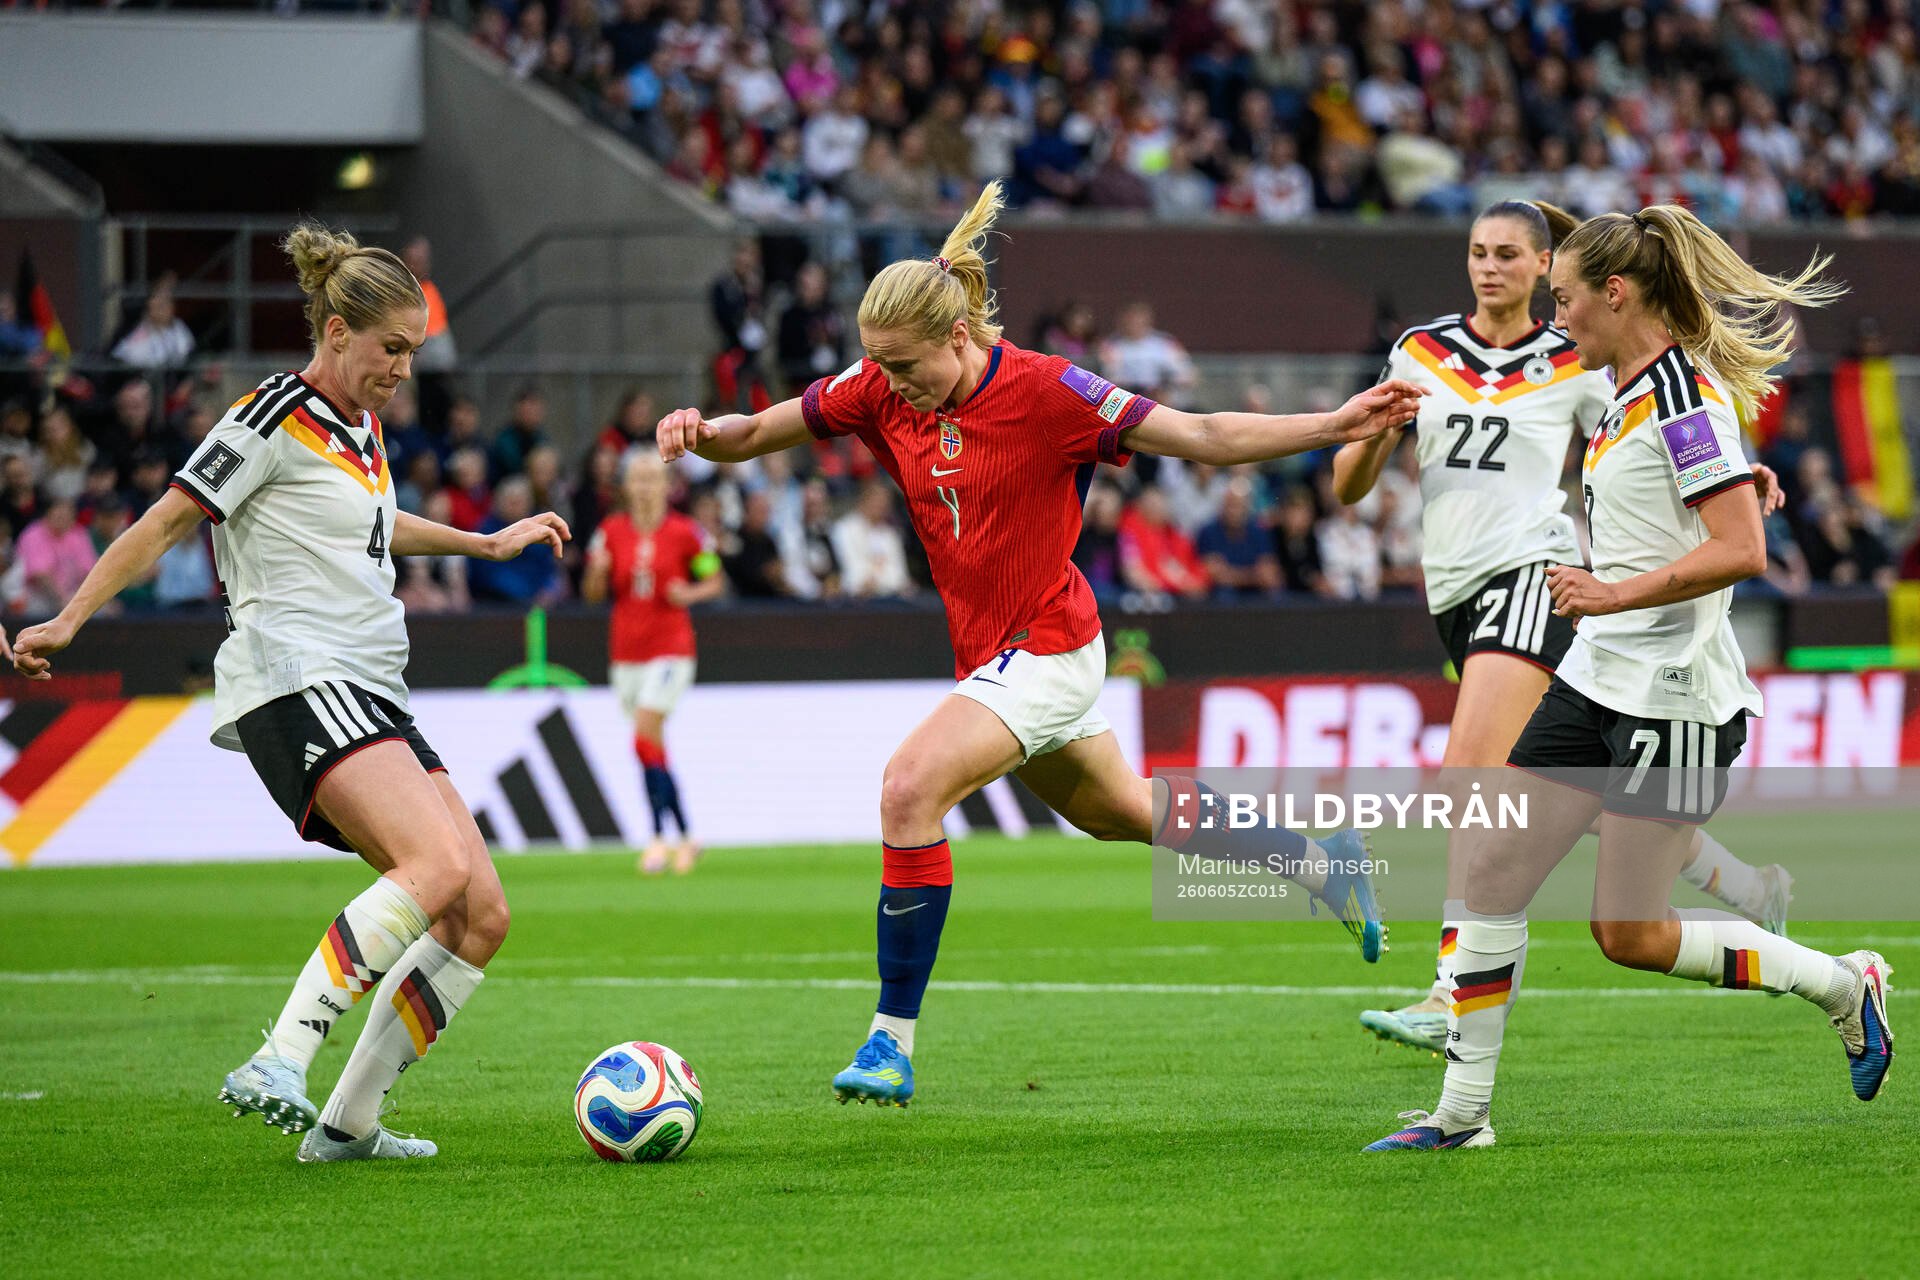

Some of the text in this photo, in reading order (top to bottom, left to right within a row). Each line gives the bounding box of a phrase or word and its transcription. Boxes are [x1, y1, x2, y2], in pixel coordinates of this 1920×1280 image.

[1103, 396, 1120, 418] FOUN
[1446, 414, 1509, 471] 22
[1677, 442, 1712, 458] EUROPEAN
[1678, 447, 1715, 463] QUALIFIERS
[1677, 462, 1729, 485] FOUNDATION
[936, 486, 960, 541] 4
[366, 506, 385, 568] 4
[1469, 588, 1509, 644] 2
[1624, 729, 1660, 794] 7
[1446, 1029, 1461, 1041] FB
